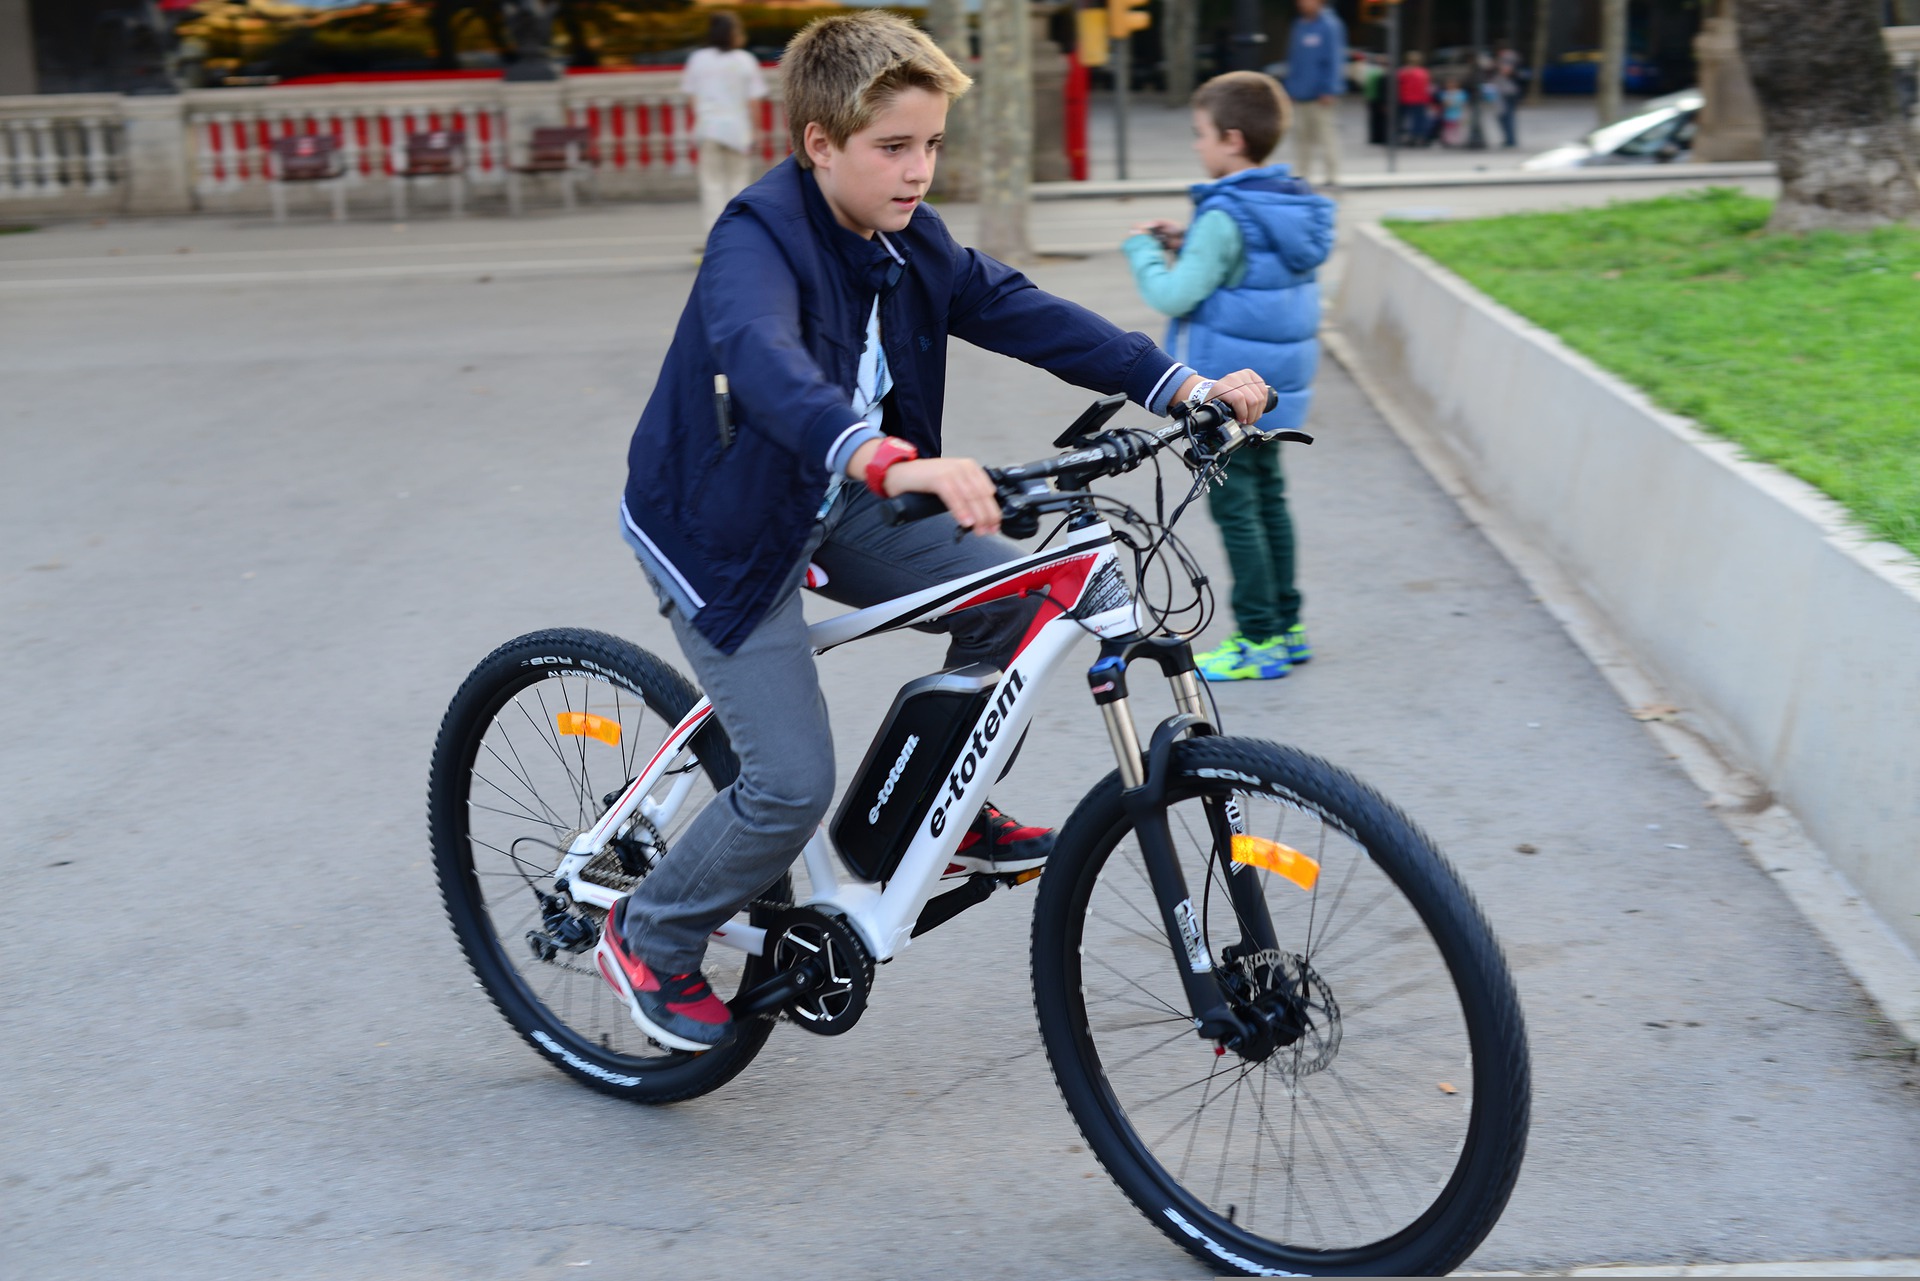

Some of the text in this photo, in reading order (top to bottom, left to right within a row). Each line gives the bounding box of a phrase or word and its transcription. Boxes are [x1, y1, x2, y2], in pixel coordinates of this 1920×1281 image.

[529, 655, 573, 667] ROB
[868, 733, 920, 826] e-totem
[930, 668, 1023, 839] e-totem
[1196, 767, 1262, 786] ROB
